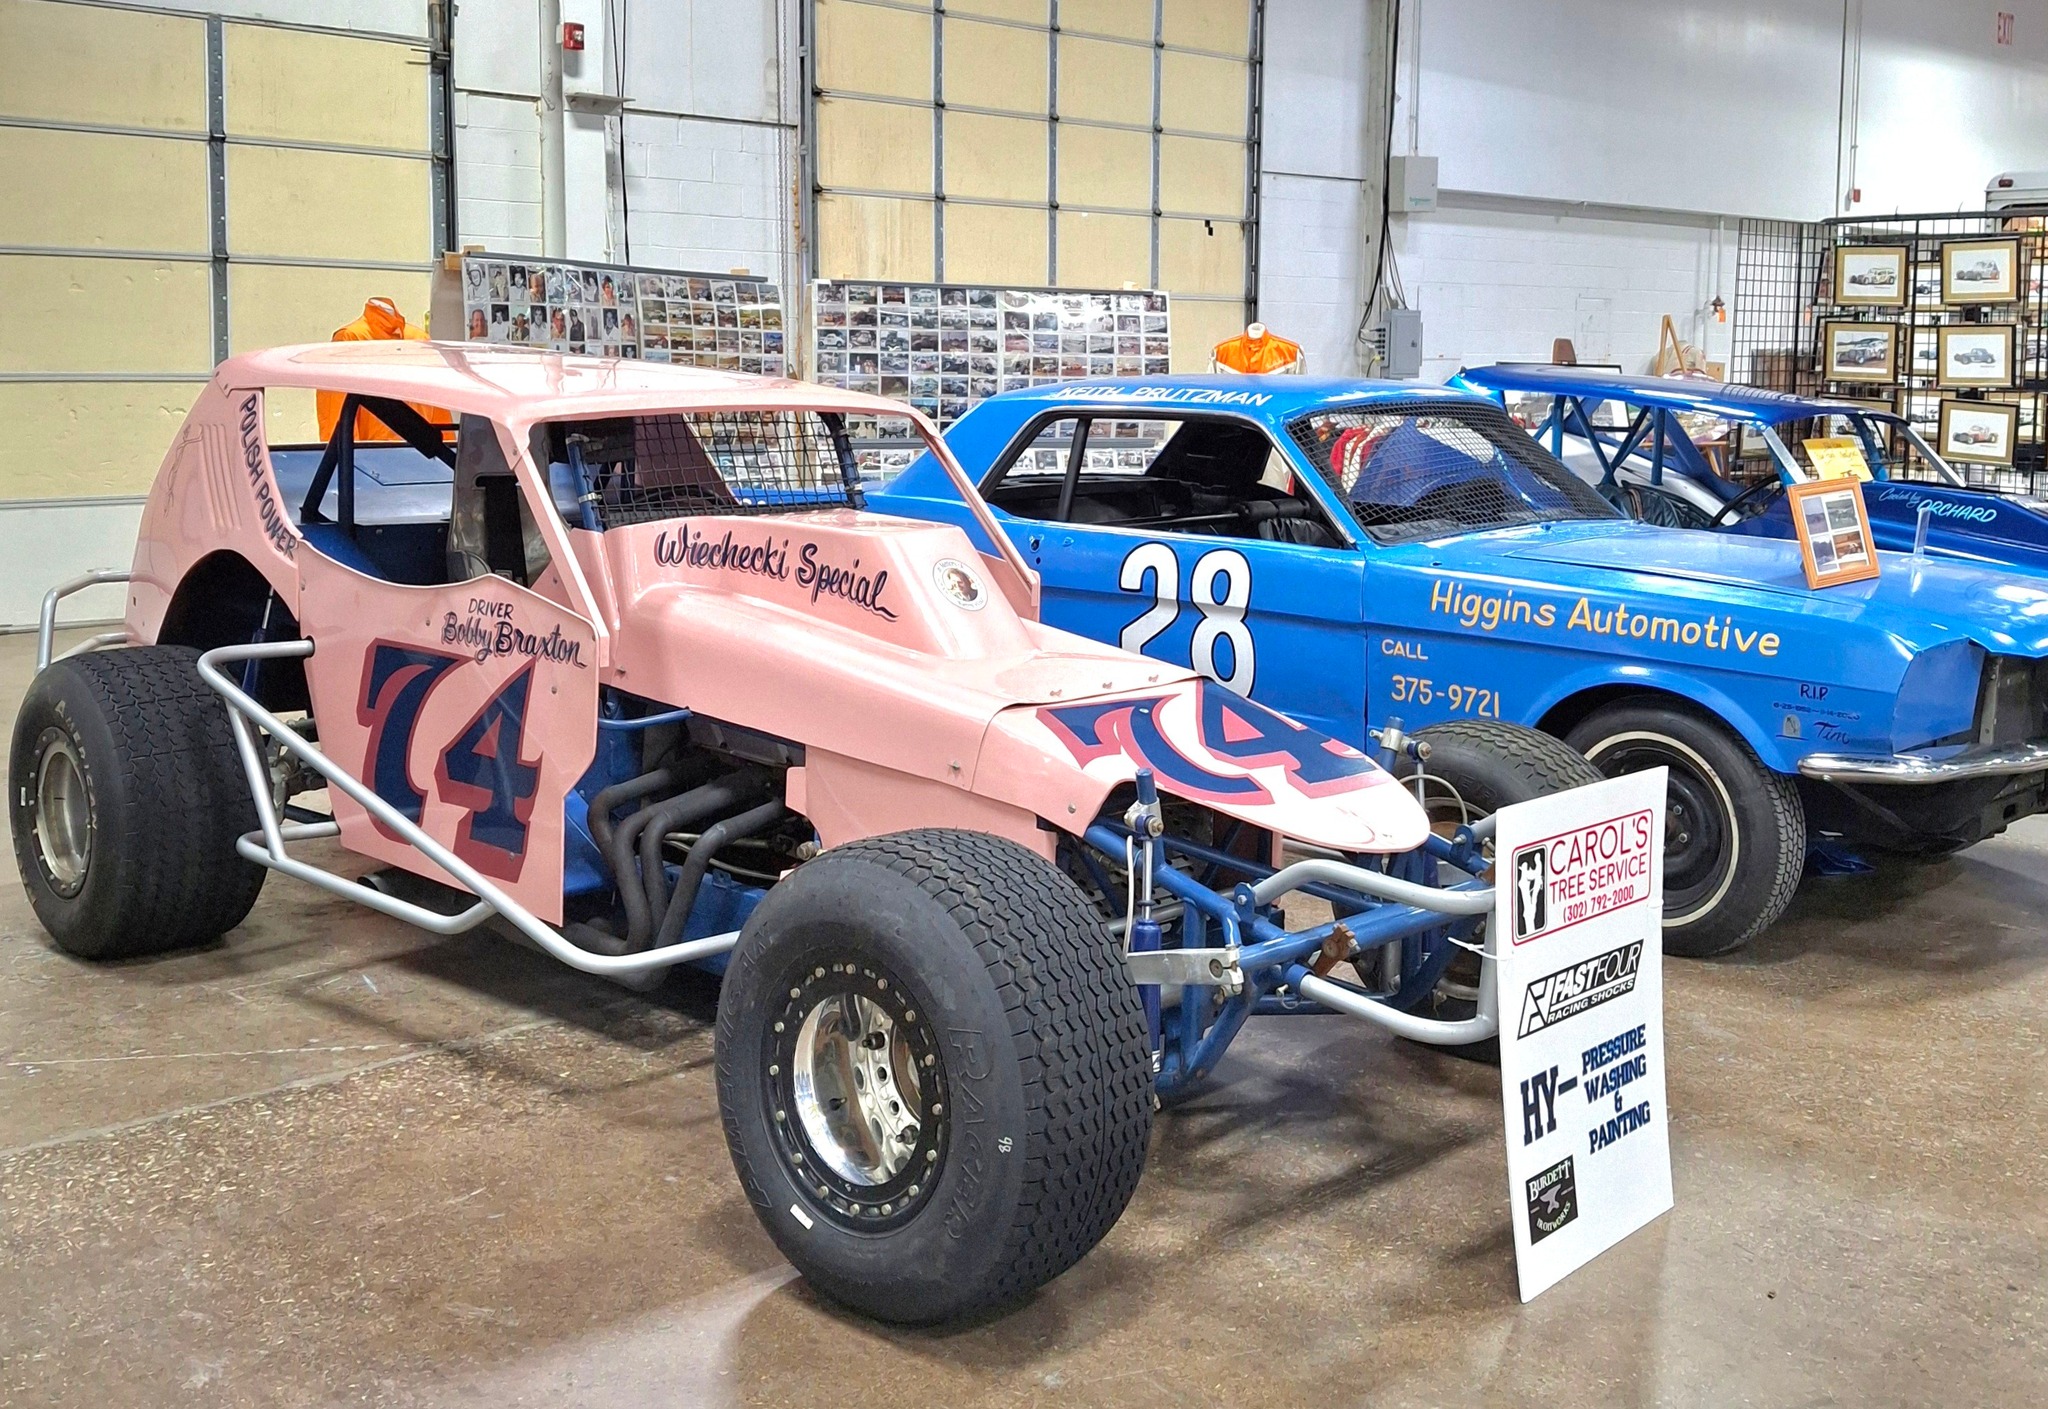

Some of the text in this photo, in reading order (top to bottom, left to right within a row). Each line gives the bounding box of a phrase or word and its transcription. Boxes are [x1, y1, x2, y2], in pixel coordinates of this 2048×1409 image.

[1997, 11, 2014, 46] EXIT
[1054, 386, 1273, 407] KEITH PRUTZMAN
[239, 392, 298, 561] POLISH POWER
[1916, 499, 1998, 523] ORCHARD
[654, 523, 899, 623] Wiechecki Special
[467, 598, 515, 621] DRIVER
[1119, 541, 1257, 698] 28
[1430, 579, 1781, 657] Higgins Automotive
[441, 610, 588, 669] Bobby Braxton
[1380, 638, 1429, 661] CALL
[1390, 674, 1500, 719] 375-9721
[1800, 683, 1829, 701] R.I.P.
[357, 638, 543, 884] 74
[1036, 677, 1393, 807] 74
[1550, 815, 1649, 876] CAROL'S
[1549, 852, 1648, 905] TREE SERVICE
[1563, 884, 1635, 924] (302) 792-2000
[1547, 978, 1635, 1024] RACING SHOCKS
[1581, 1023, 1647, 1077] PRESSURE
[1584, 1053, 1647, 1105] WASHING
[1613, 1089, 1623, 1113] &
[1588, 1099, 1651, 1156] PAINTING
[1528, 1158, 1572, 1203] BURDETT
[1536, 1199, 1571, 1232] IRONWORKS
